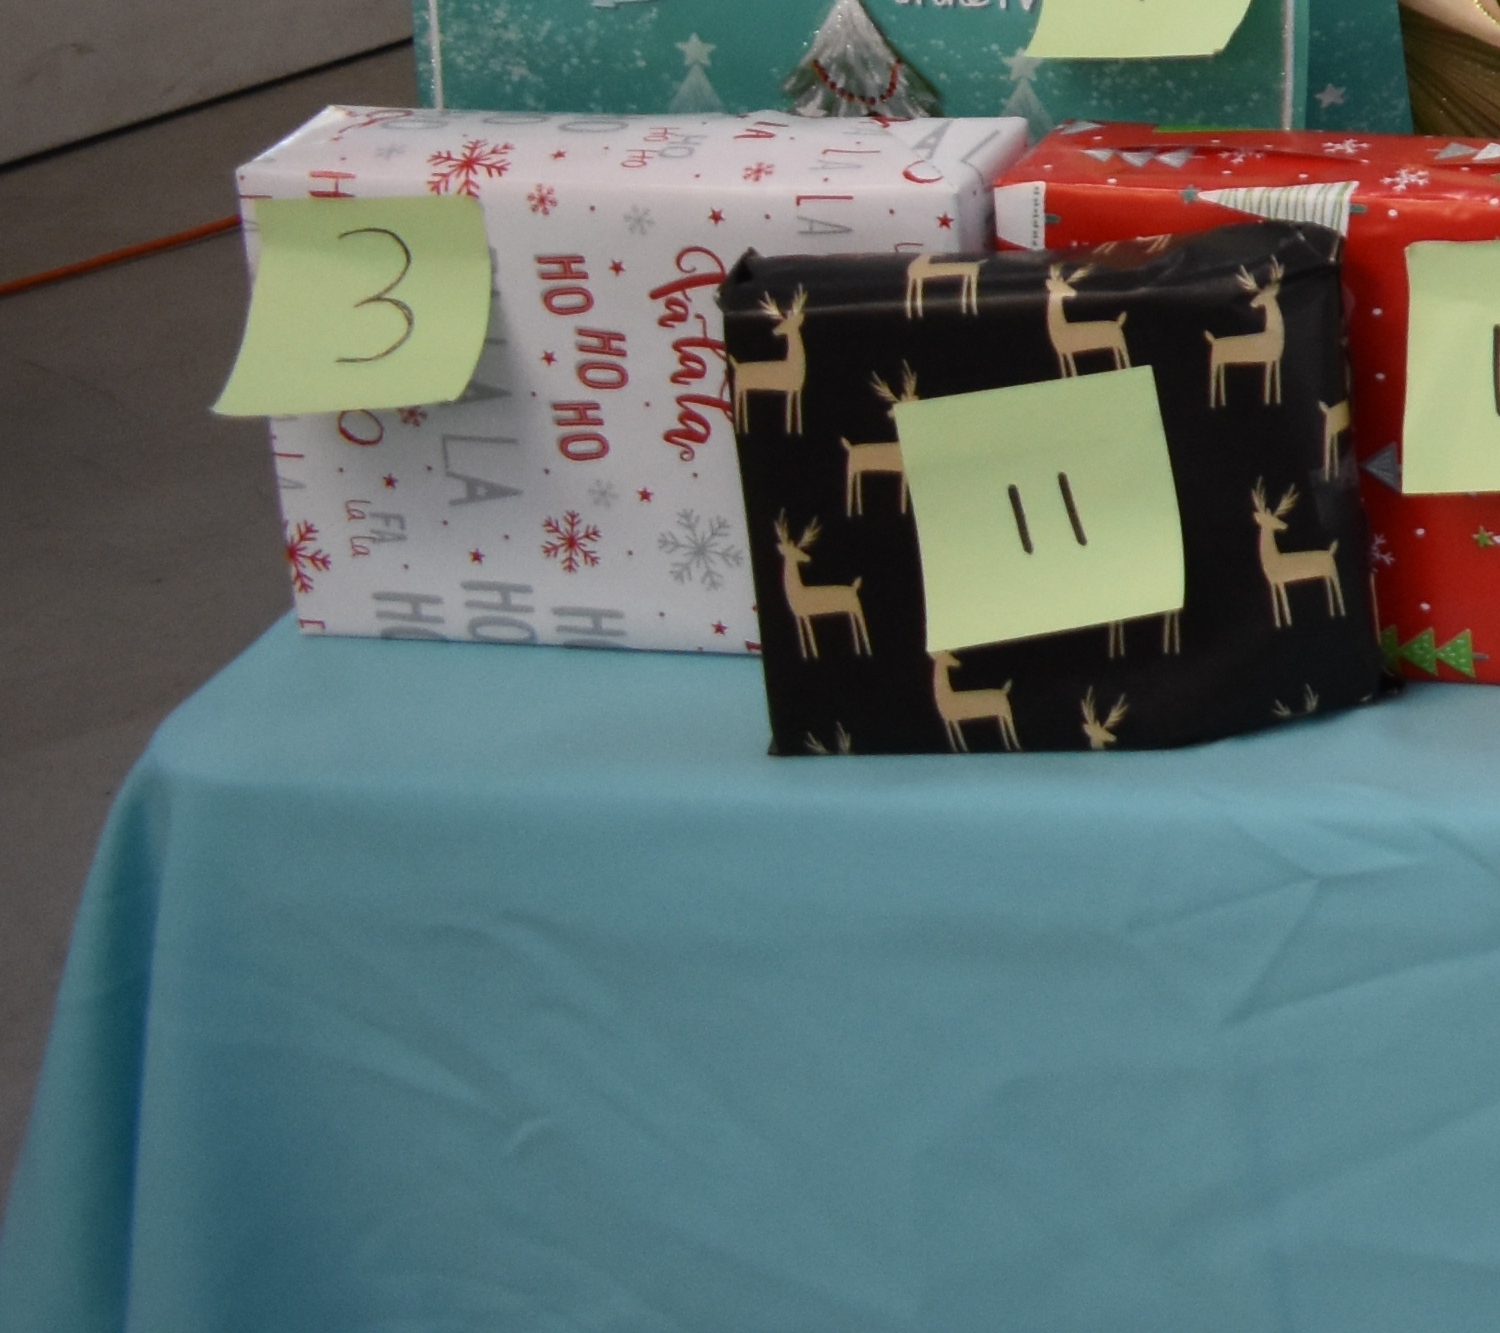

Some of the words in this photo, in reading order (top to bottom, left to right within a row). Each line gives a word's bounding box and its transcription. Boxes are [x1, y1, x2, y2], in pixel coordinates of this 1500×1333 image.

[336, 226, 415, 364] 3
[535, 254, 595, 316] HO
[577, 328, 629, 390] HO
[552, 402, 610, 462] HO
[443, 434, 523, 507] LA
[1007, 471, 1088, 555] 11
